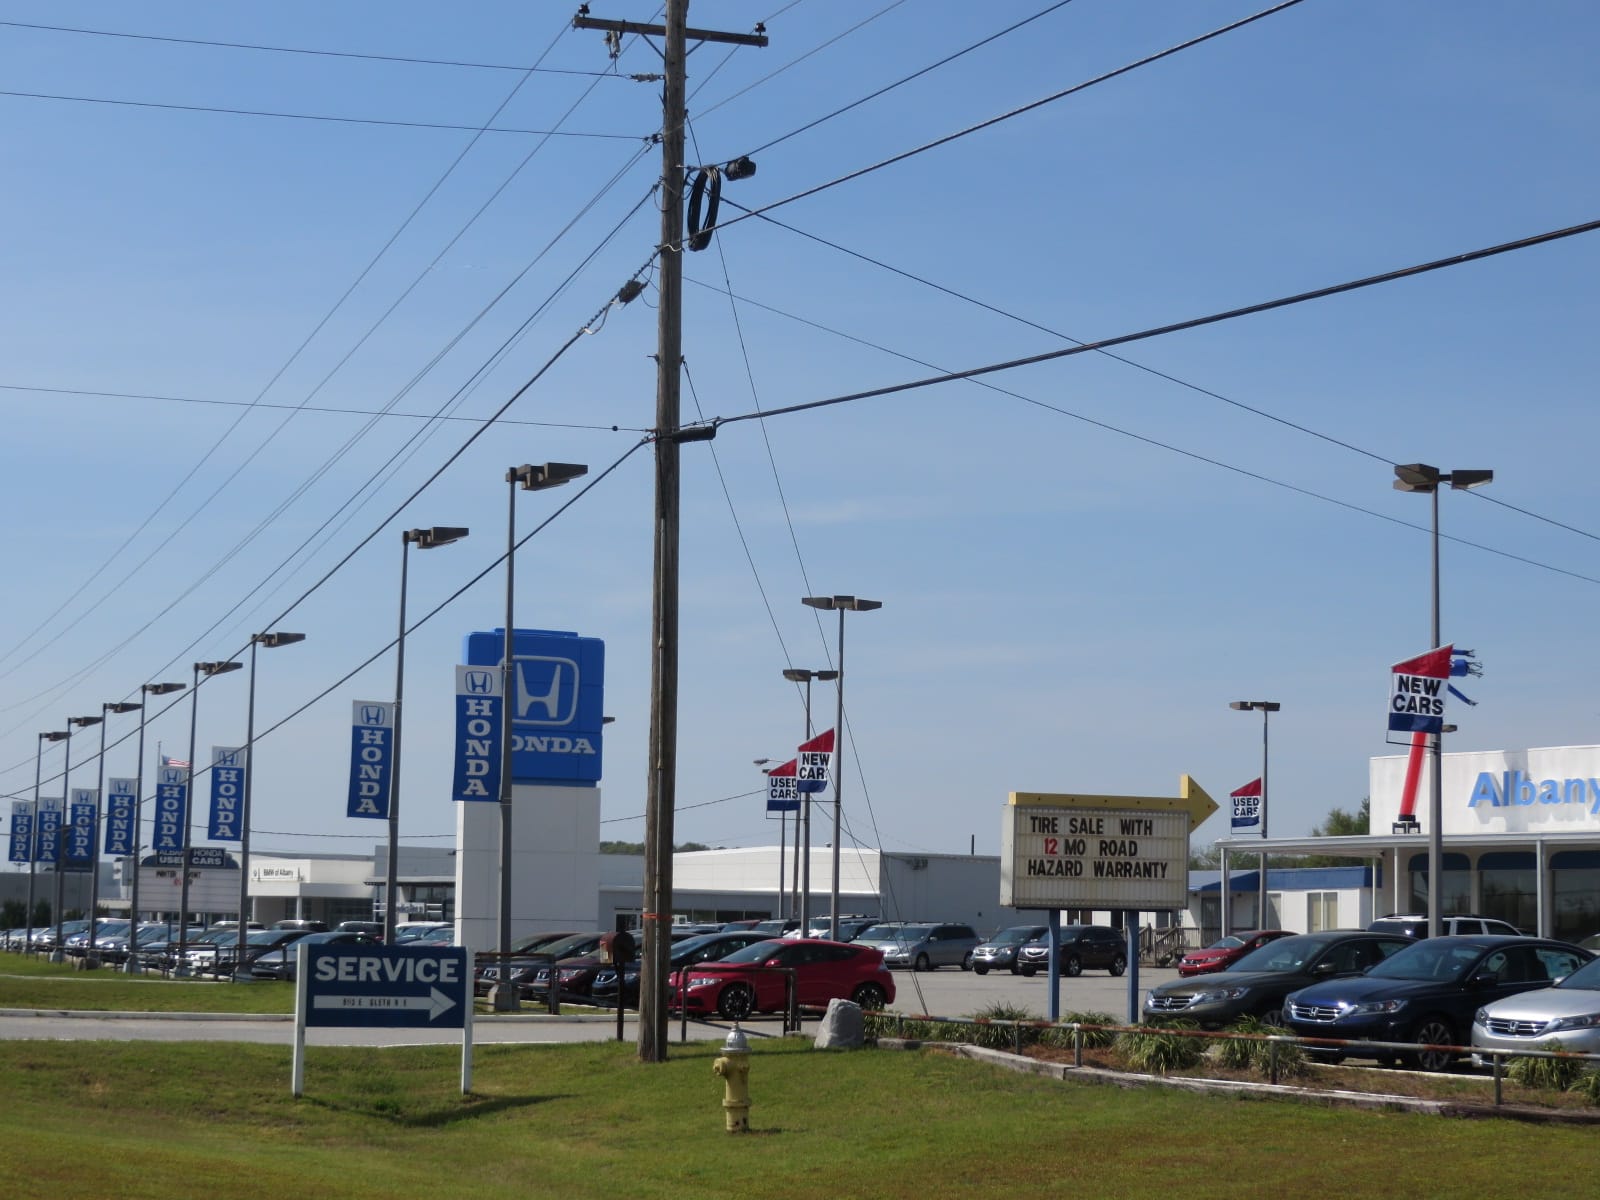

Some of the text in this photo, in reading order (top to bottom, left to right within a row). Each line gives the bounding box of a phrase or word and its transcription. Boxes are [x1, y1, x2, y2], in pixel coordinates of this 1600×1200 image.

[1397, 675, 1442, 697] NEW
[1392, 694, 1444, 716] CARS
[462, 699, 493, 796] HONDA
[511, 735, 596, 754] ONDA
[802, 753, 830, 766] NEW
[356, 729, 385, 813] HONDA
[771, 778, 797, 788] USED
[771, 788, 798, 799] CARS
[214, 769, 239, 837] HONDA
[1233, 798, 1259, 807] USED
[111, 796, 130, 852] HONDA
[158, 787, 181, 847] HONDA
[1030, 816, 1153, 836] TIRE SALE WITH
[13, 816, 29, 859] HONDA
[40, 813, 57, 859] HONDA
[72, 806, 90, 856] HONDA
[1044, 838, 1138, 857] 12 MO ROAD
[192, 857, 222, 865] CARS
[1028, 859, 1168, 879] HAZARD WARRANTY
[315, 956, 459, 983] SERVICE
